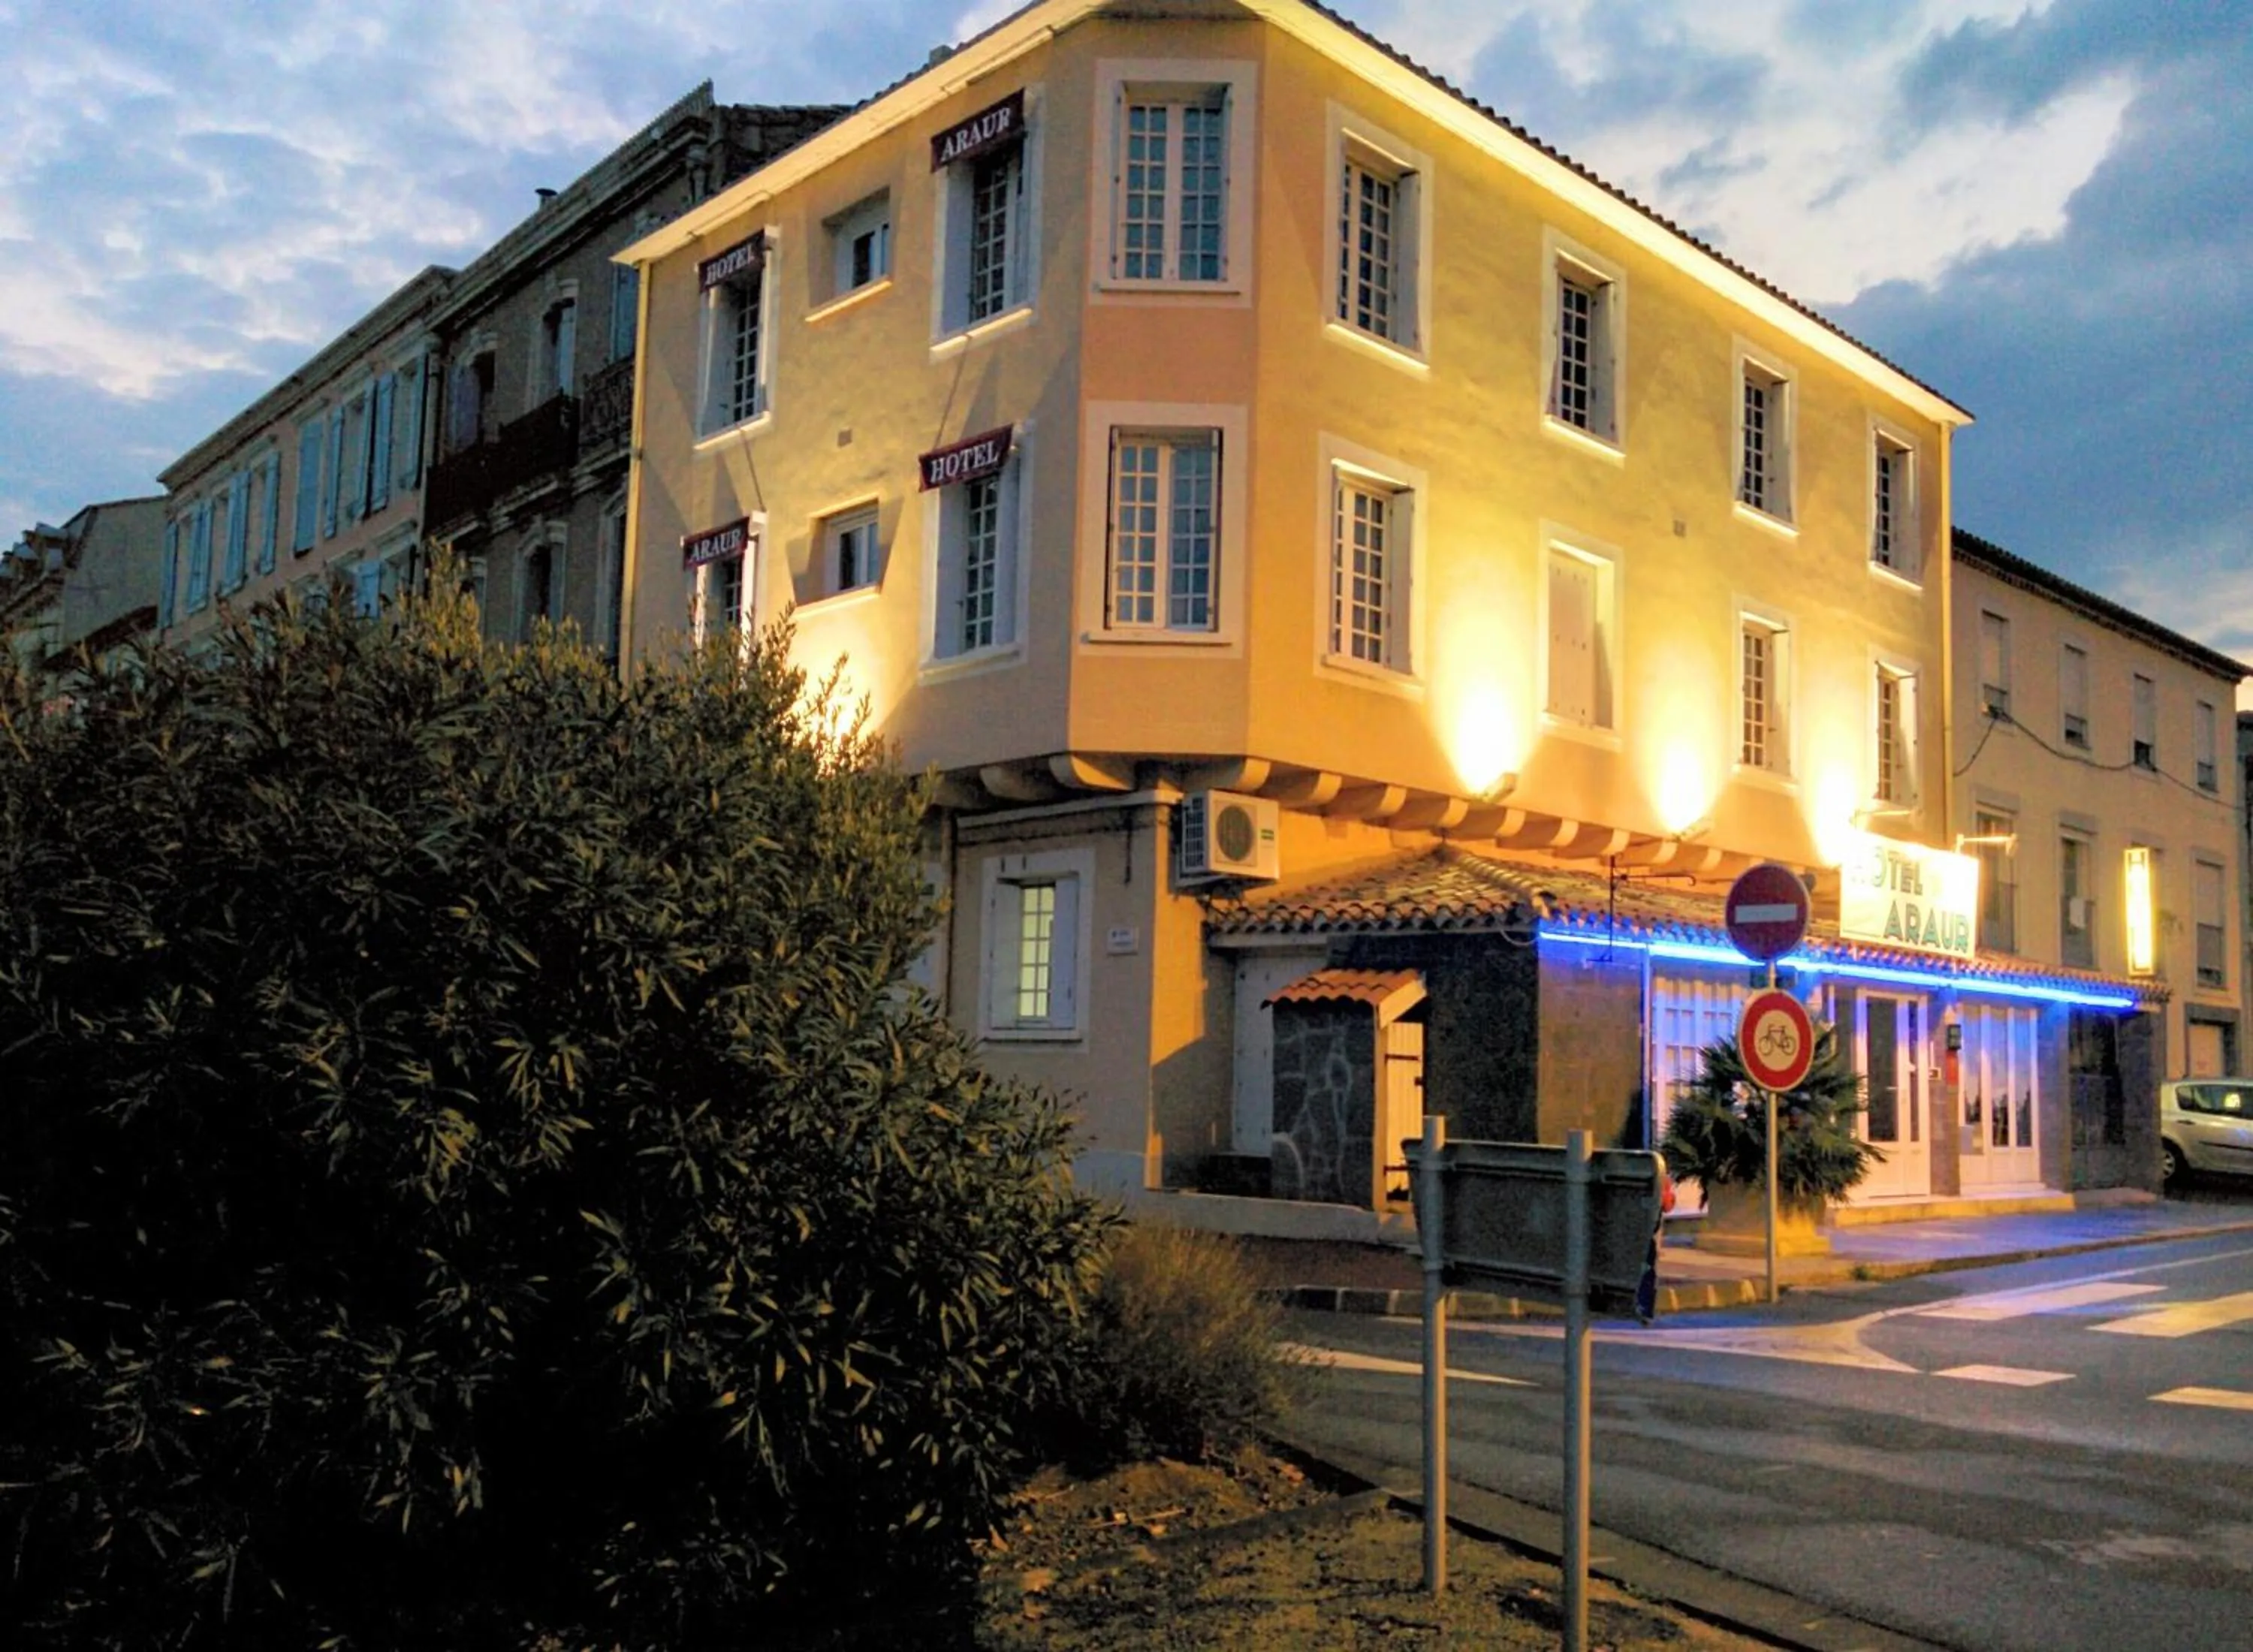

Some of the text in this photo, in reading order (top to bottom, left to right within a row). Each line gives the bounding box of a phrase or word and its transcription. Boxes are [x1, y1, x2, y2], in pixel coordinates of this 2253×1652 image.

[940, 107, 1011, 162] ARAUR
[706, 243, 755, 285] HOTEL
[930, 441, 998, 484] HOTEL
[689, 528, 741, 562] ARAUR
[1850, 844, 1923, 896] OTEL
[1883, 900, 1970, 954] ARAUR
